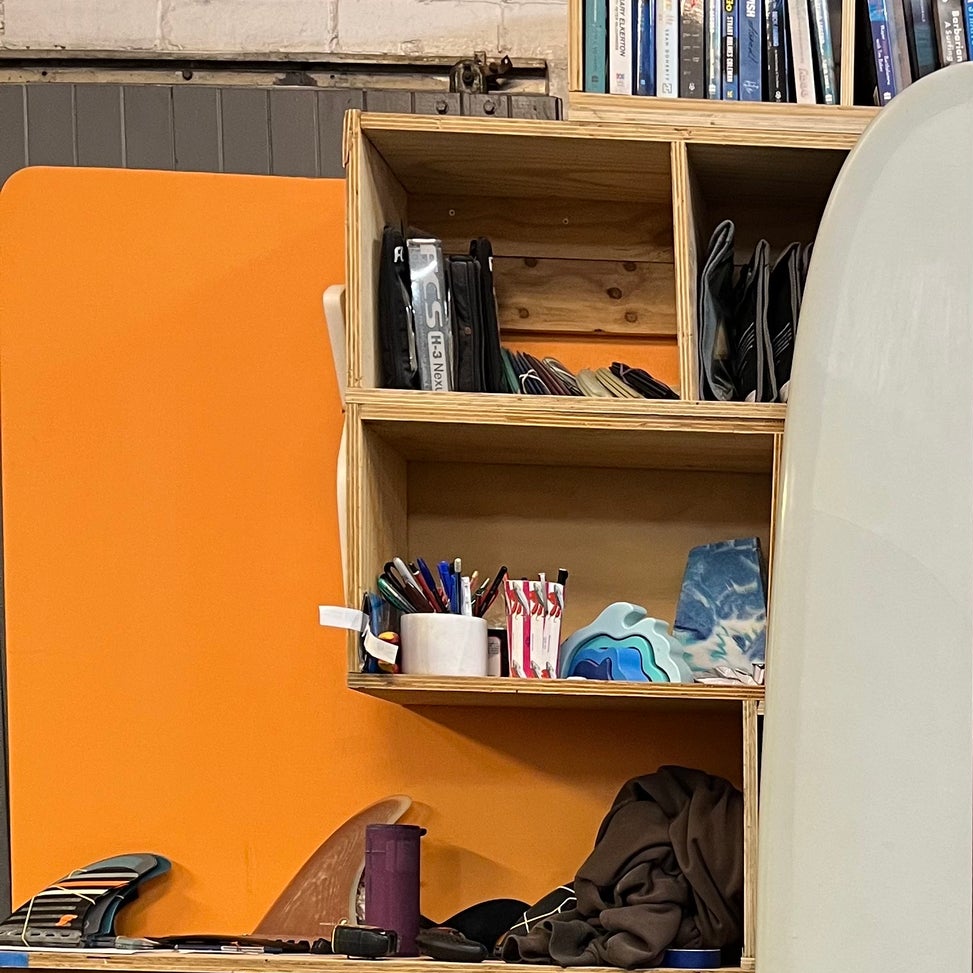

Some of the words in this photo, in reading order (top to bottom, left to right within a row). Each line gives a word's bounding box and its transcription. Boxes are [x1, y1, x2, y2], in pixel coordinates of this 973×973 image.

[944, 30, 954, 62] Surfing
[952, 10, 963, 62] Barbarian
[431, 335, 443, 359] H-3
